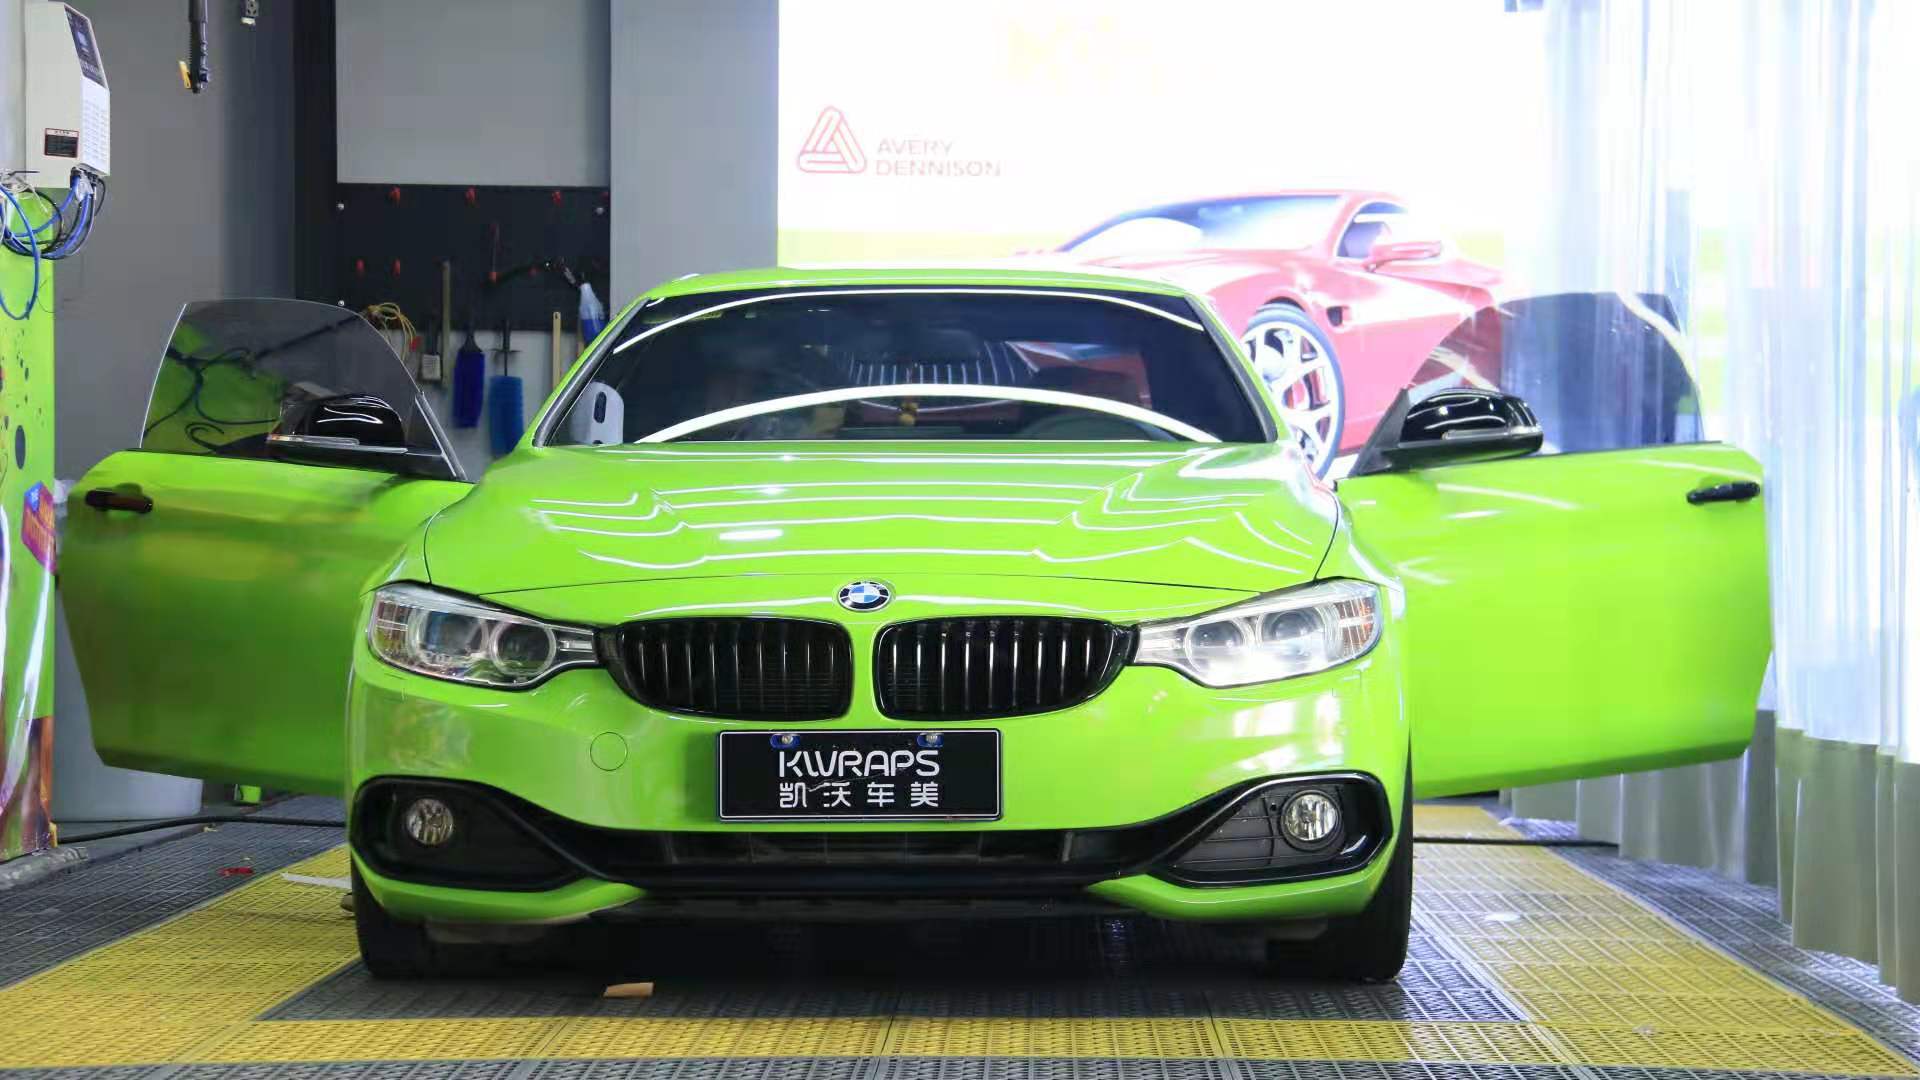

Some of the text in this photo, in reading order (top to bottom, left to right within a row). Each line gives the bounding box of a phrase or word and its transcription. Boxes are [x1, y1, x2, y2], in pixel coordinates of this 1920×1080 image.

[878, 139, 953, 155] AVERY
[876, 160, 1001, 176] DENNISON
[779, 750, 940, 777] KWRAPS
[779, 782, 939, 808] 凯沃车美
